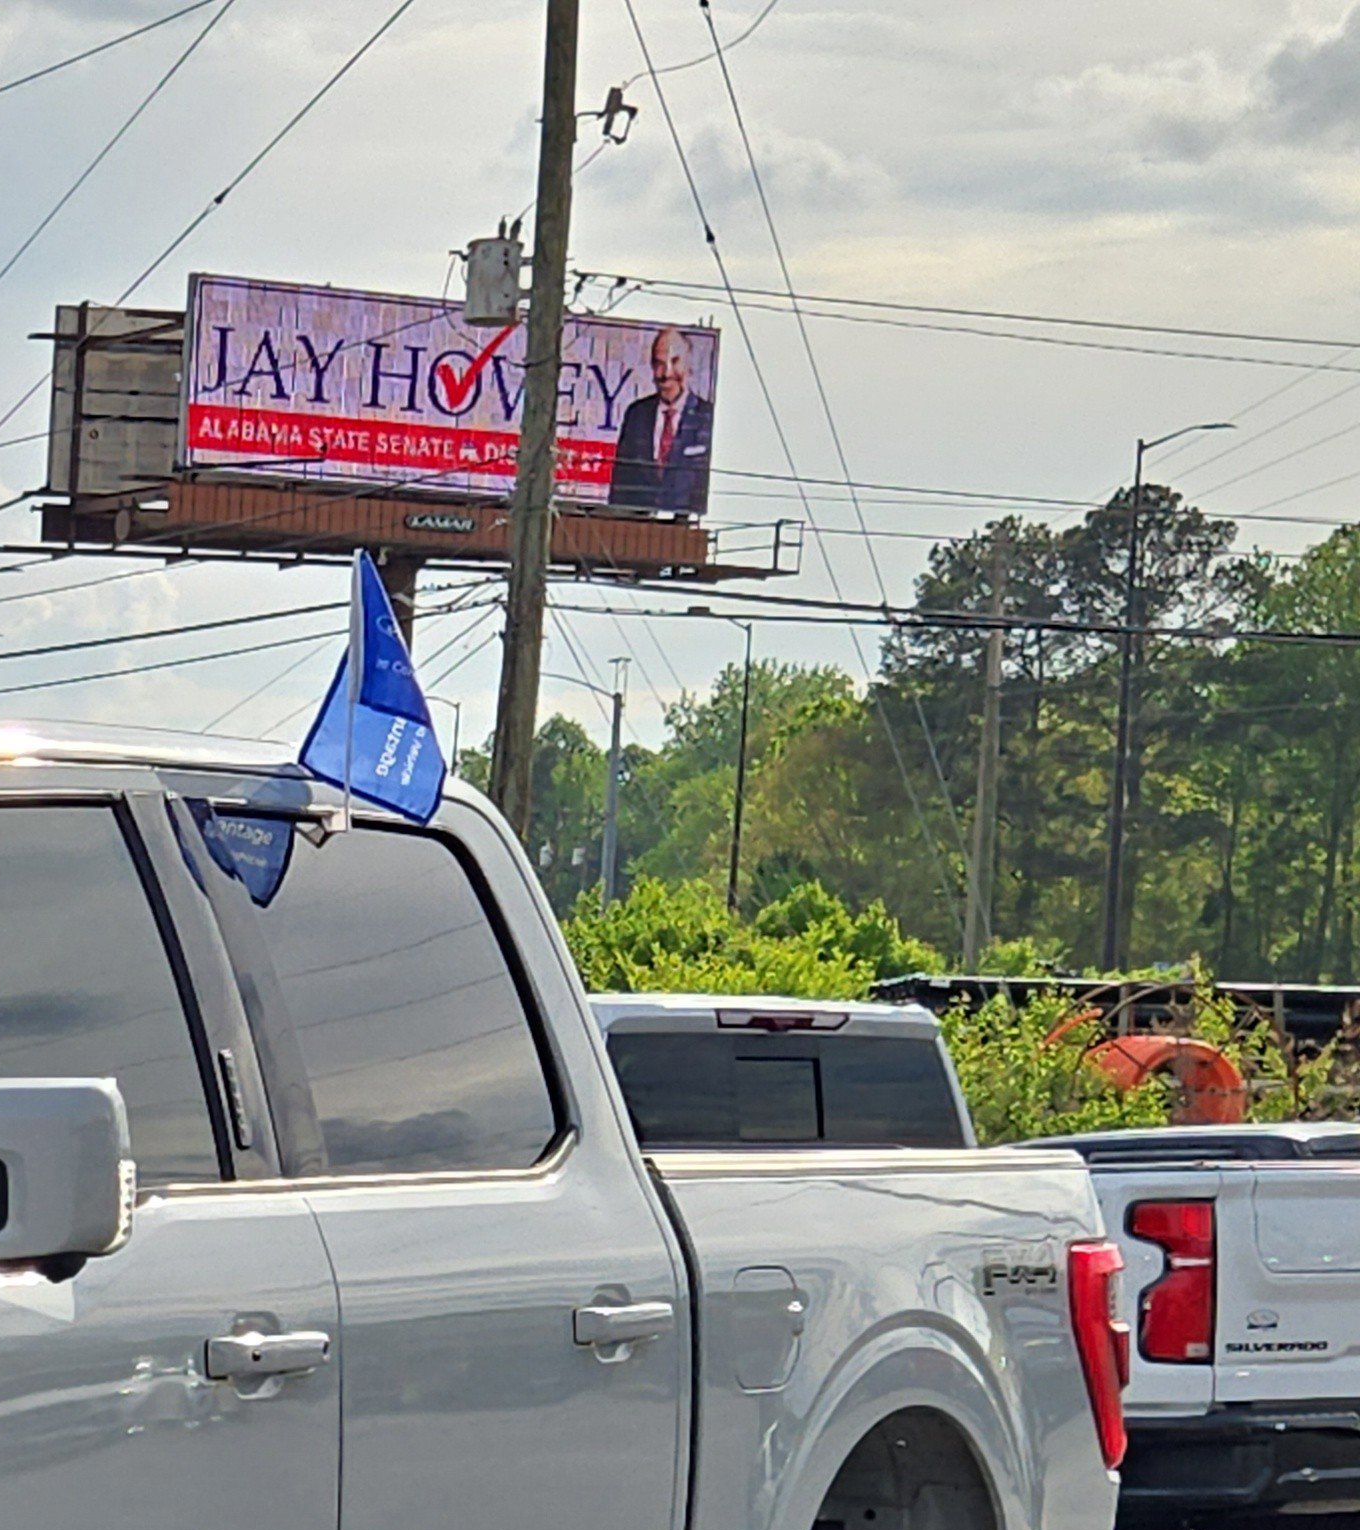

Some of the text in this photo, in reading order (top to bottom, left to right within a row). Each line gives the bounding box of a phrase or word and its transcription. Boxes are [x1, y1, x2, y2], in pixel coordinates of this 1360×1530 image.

[202, 325, 345, 404] JAY
[197, 415, 303, 446] ALABAMA
[308, 426, 371, 452] STATE
[375, 431, 454, 459] SENATE
[1224, 1340, 1329, 1354] SILVERADO
